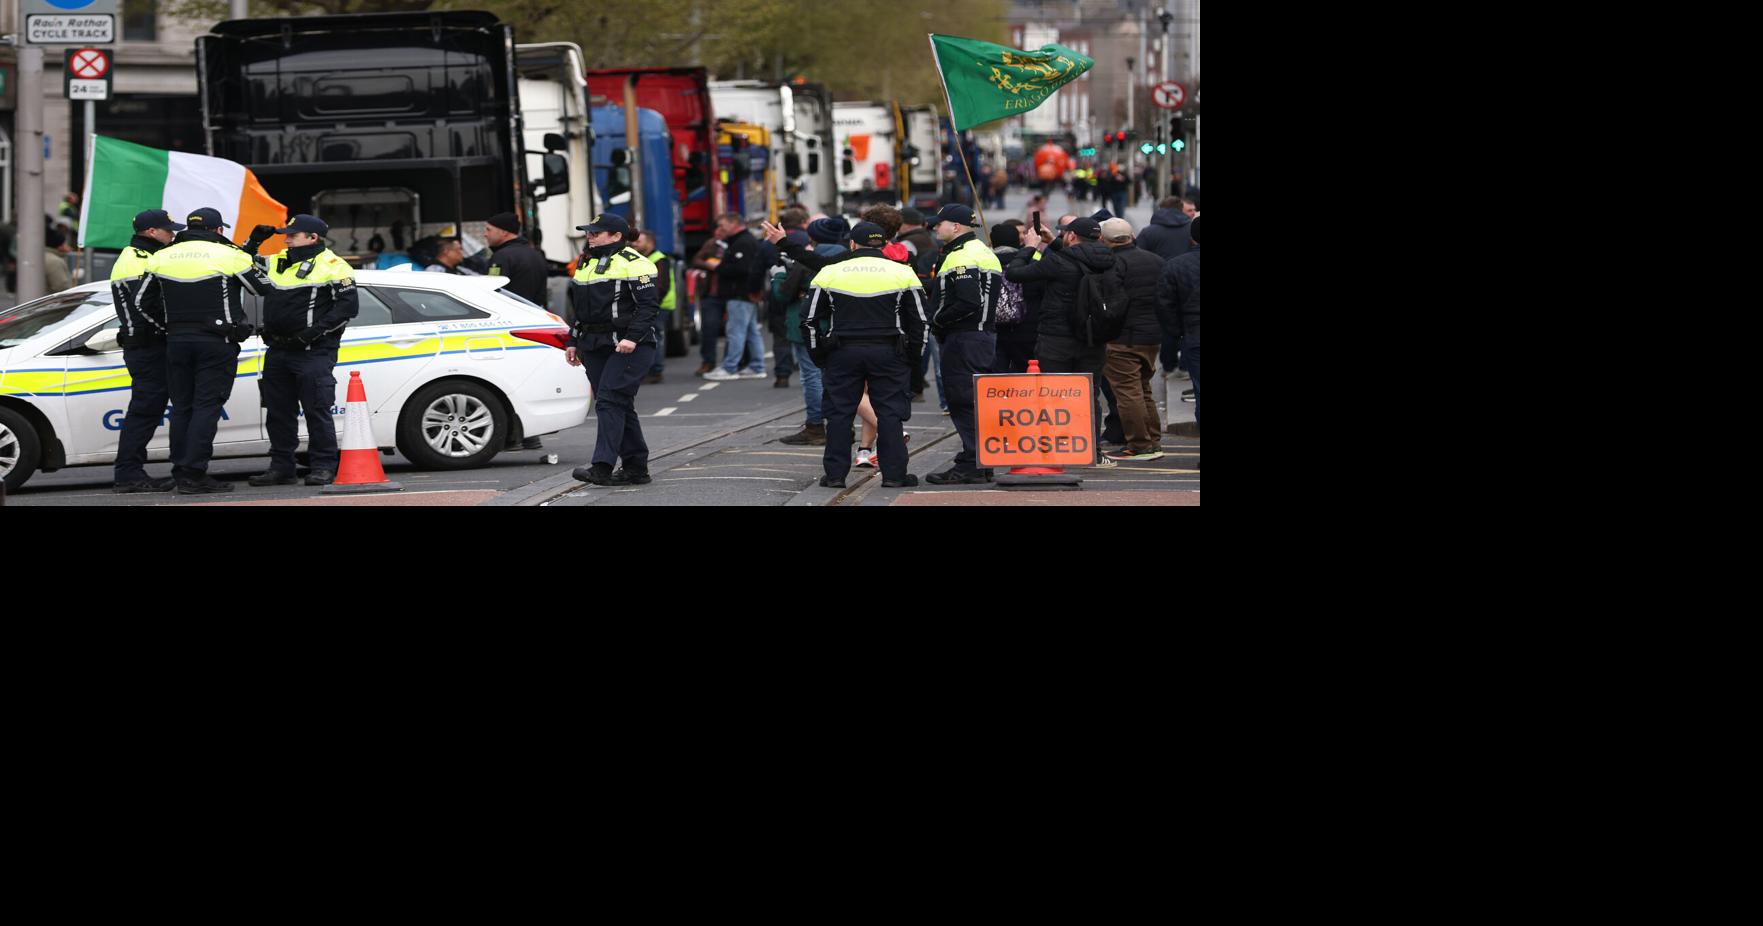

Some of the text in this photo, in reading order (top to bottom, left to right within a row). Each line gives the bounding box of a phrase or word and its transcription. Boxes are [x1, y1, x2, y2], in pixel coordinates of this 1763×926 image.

[33, 29, 107, 38] CYCLE TRACK
[72, 85, 88, 93] 24
[169, 252, 210, 260] GARDA
[842, 265, 887, 273] GARDA
[986, 387, 1035, 399] Bothar
[998, 408, 1071, 427] ROAD
[984, 435, 1088, 455] CLOSED
